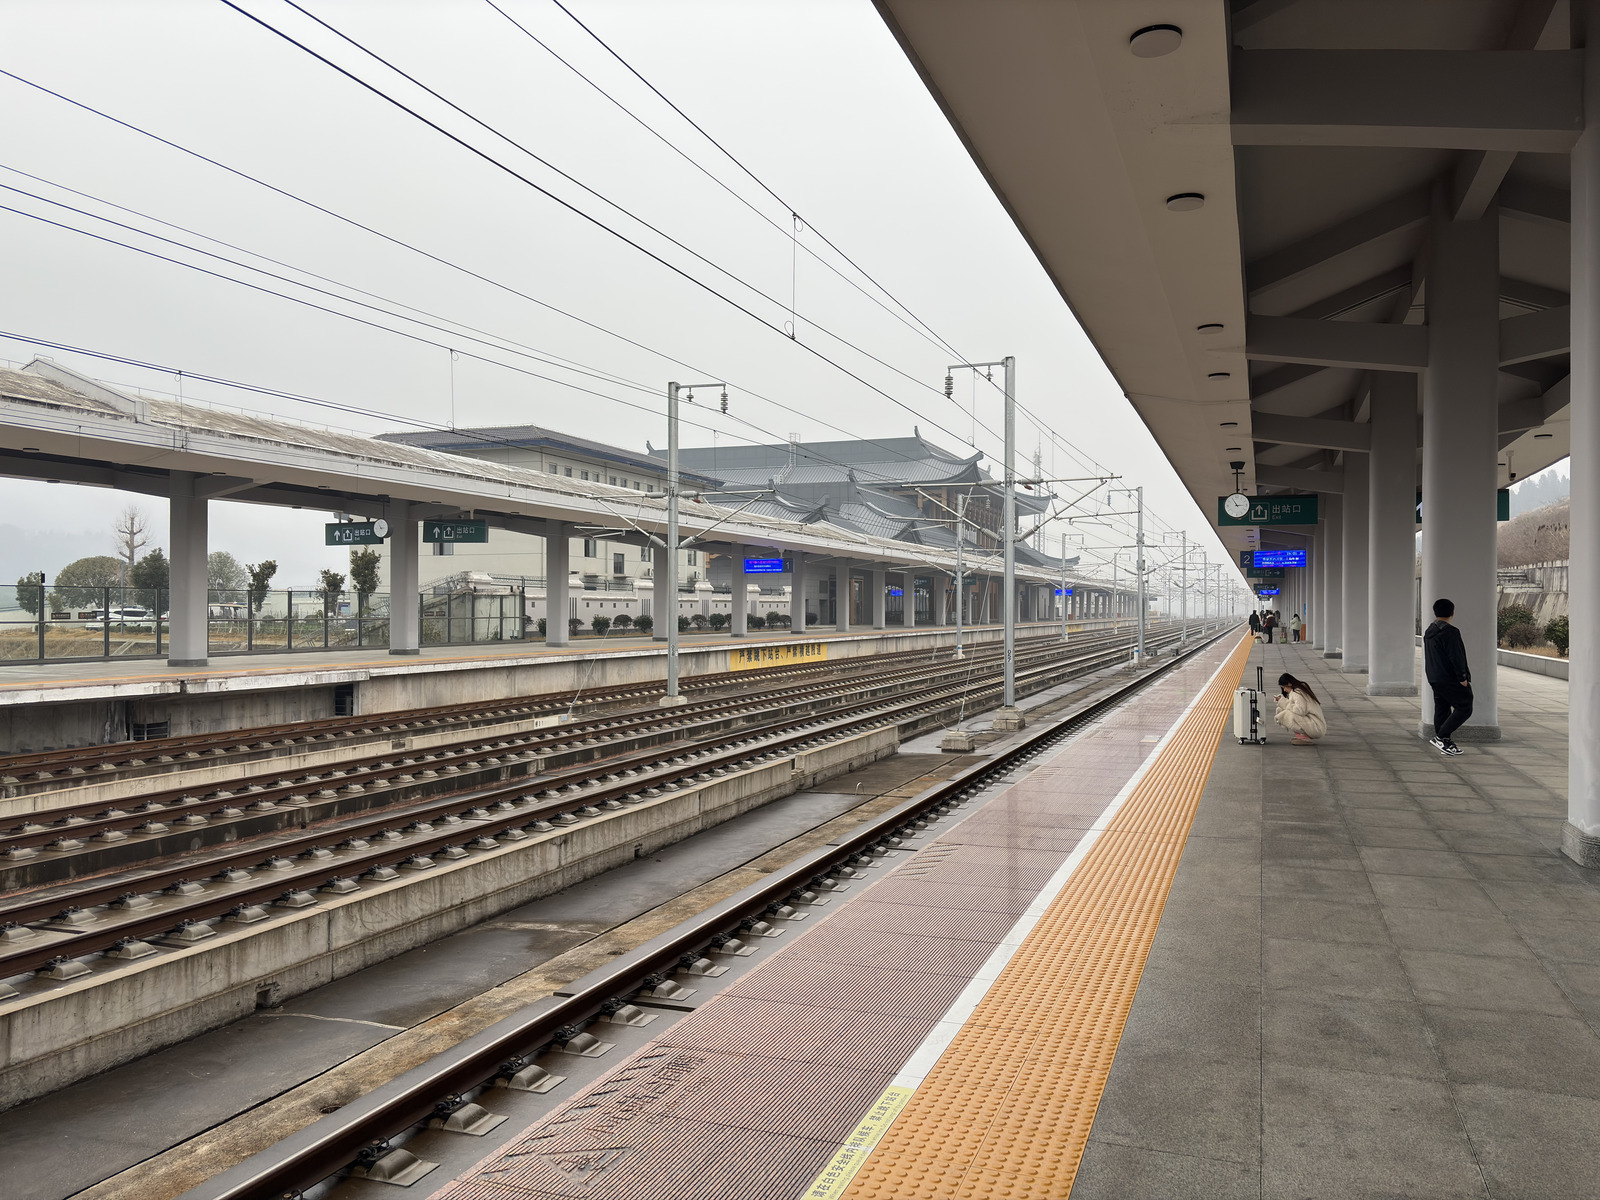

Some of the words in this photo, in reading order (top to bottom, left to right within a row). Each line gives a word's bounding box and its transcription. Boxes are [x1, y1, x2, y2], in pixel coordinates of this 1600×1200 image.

[1272, 504, 1301, 514] 出站口
[354, 528, 371, 536] 出站口
[456, 526, 475, 534] 出站口
[1243, 554, 1251, 564] 2
